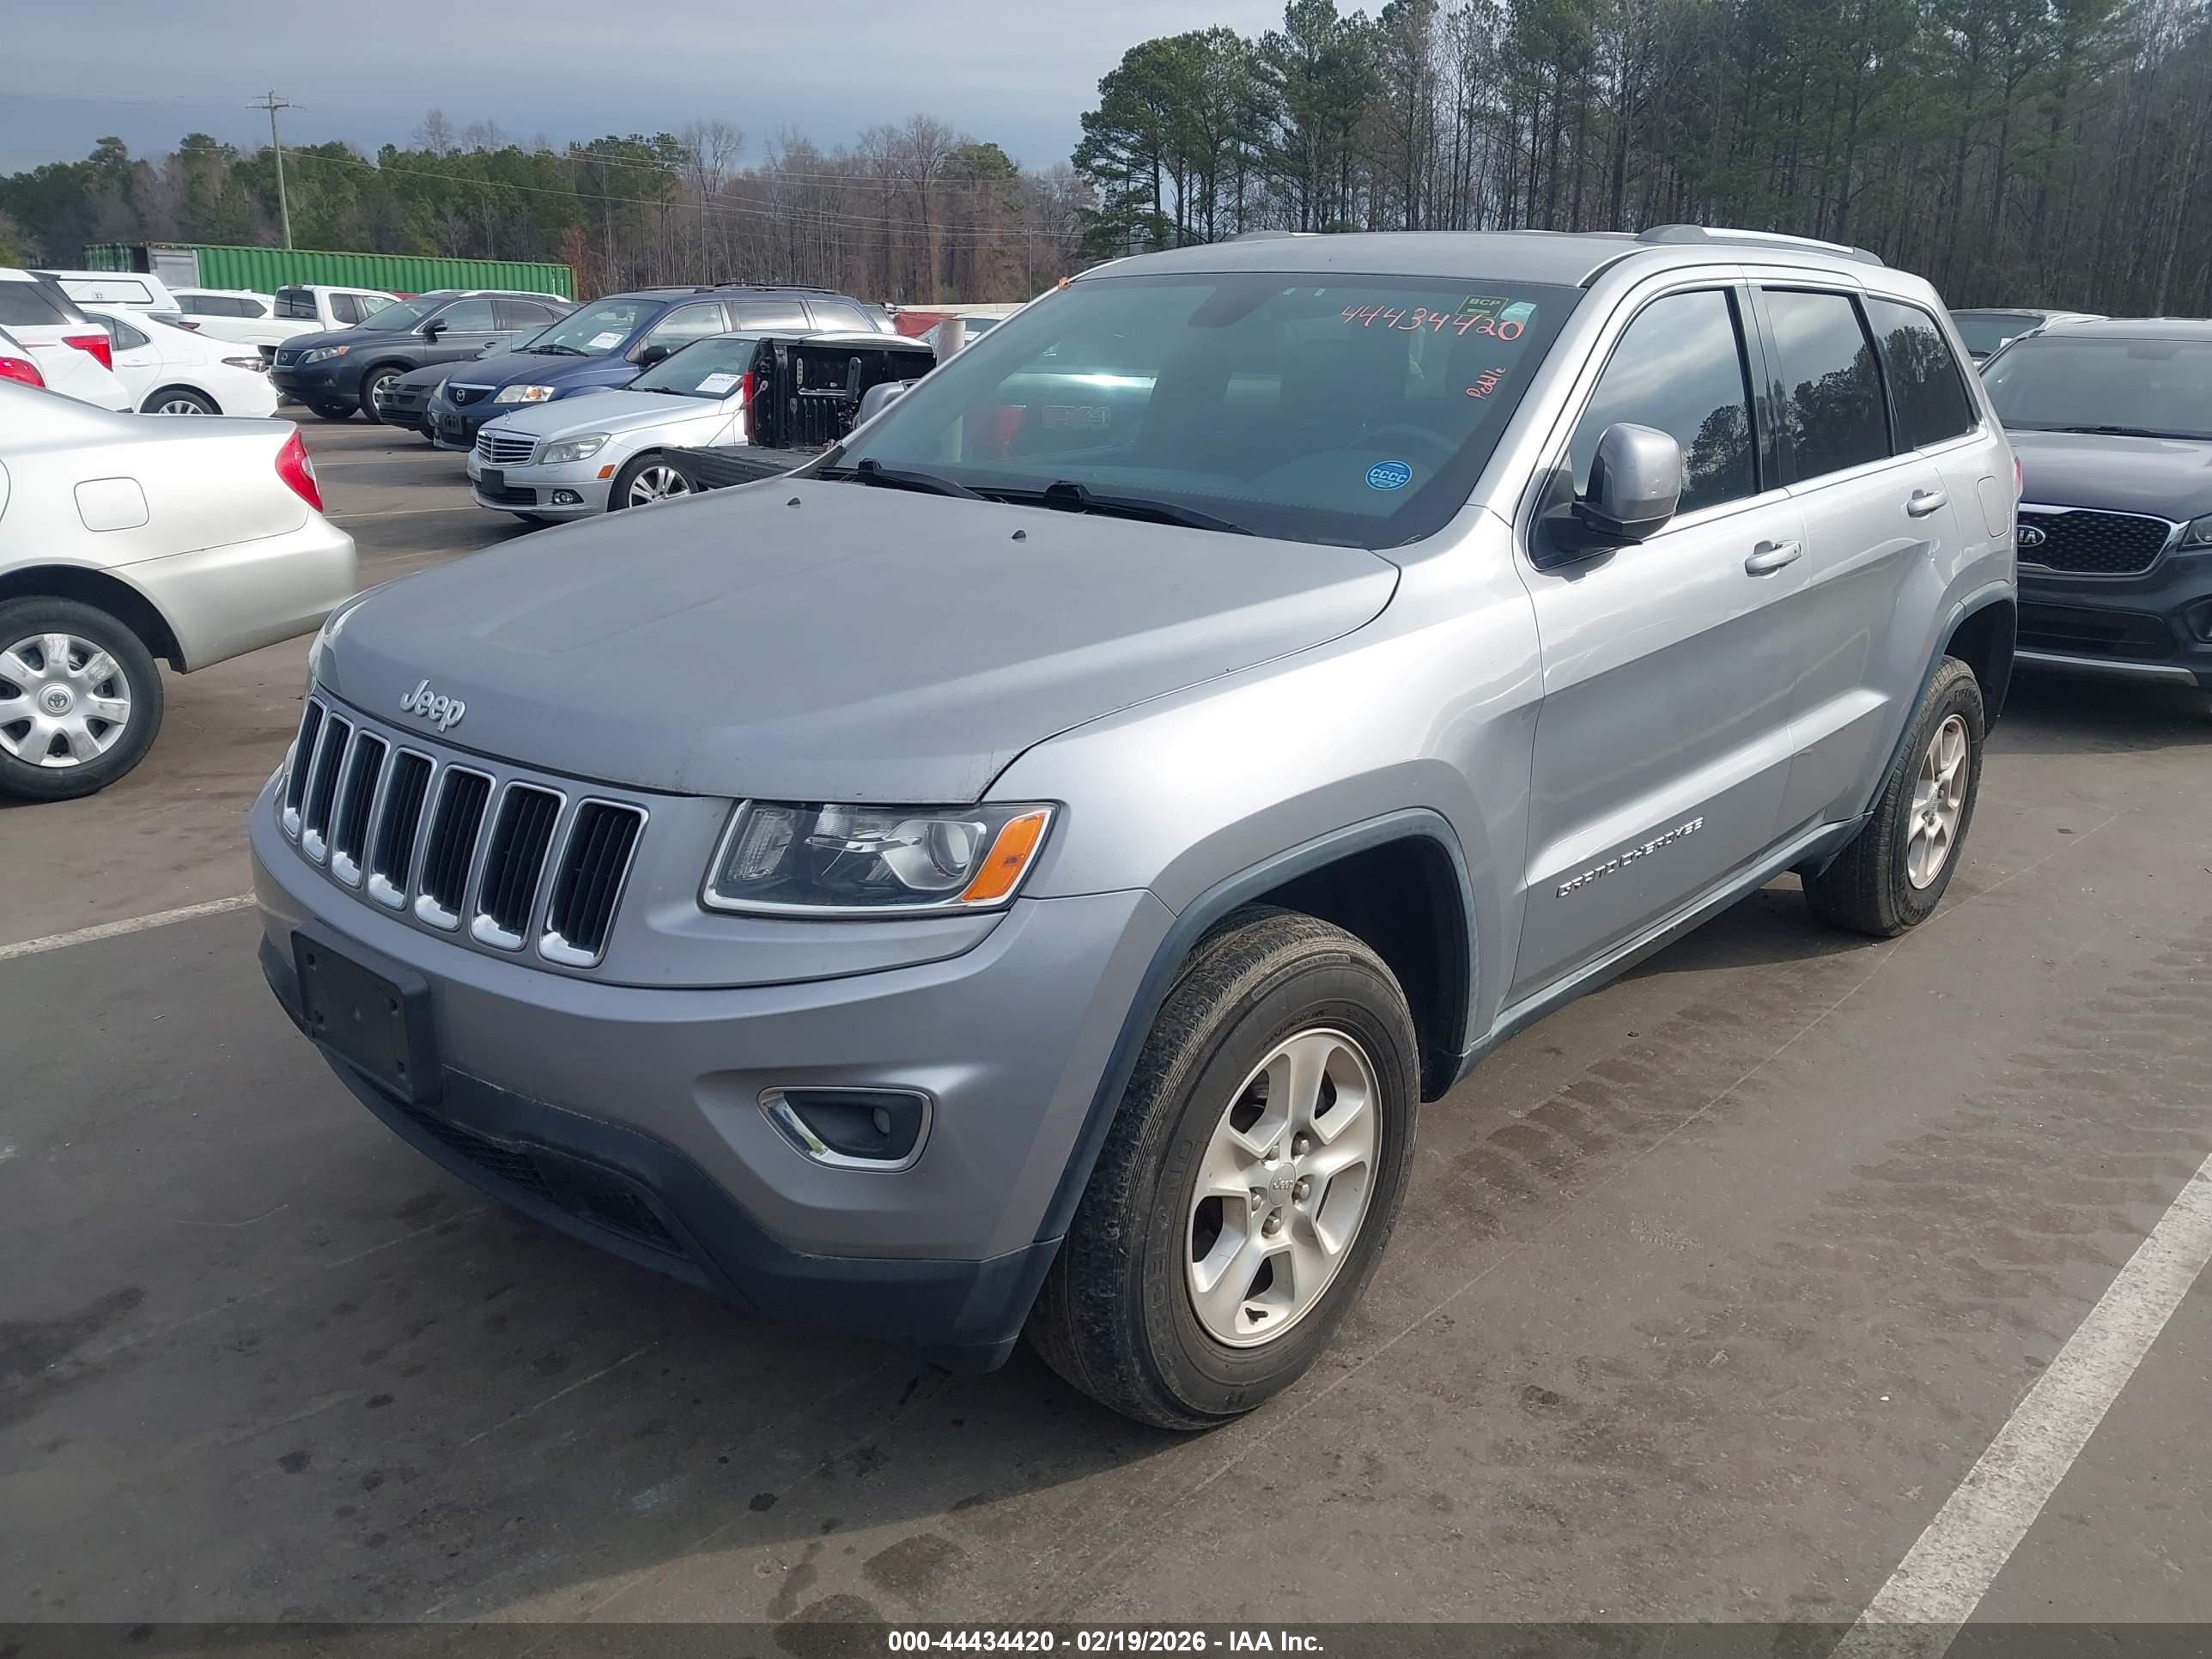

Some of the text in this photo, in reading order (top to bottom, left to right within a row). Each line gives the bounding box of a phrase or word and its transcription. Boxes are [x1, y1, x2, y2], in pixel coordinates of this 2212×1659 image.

[1341, 304, 1526, 341] 44434420
[1468, 297, 1501, 307] BCP
[399, 678, 466, 732] Jeep
[1556, 816, 1704, 898] GRAND CHEROKEE
